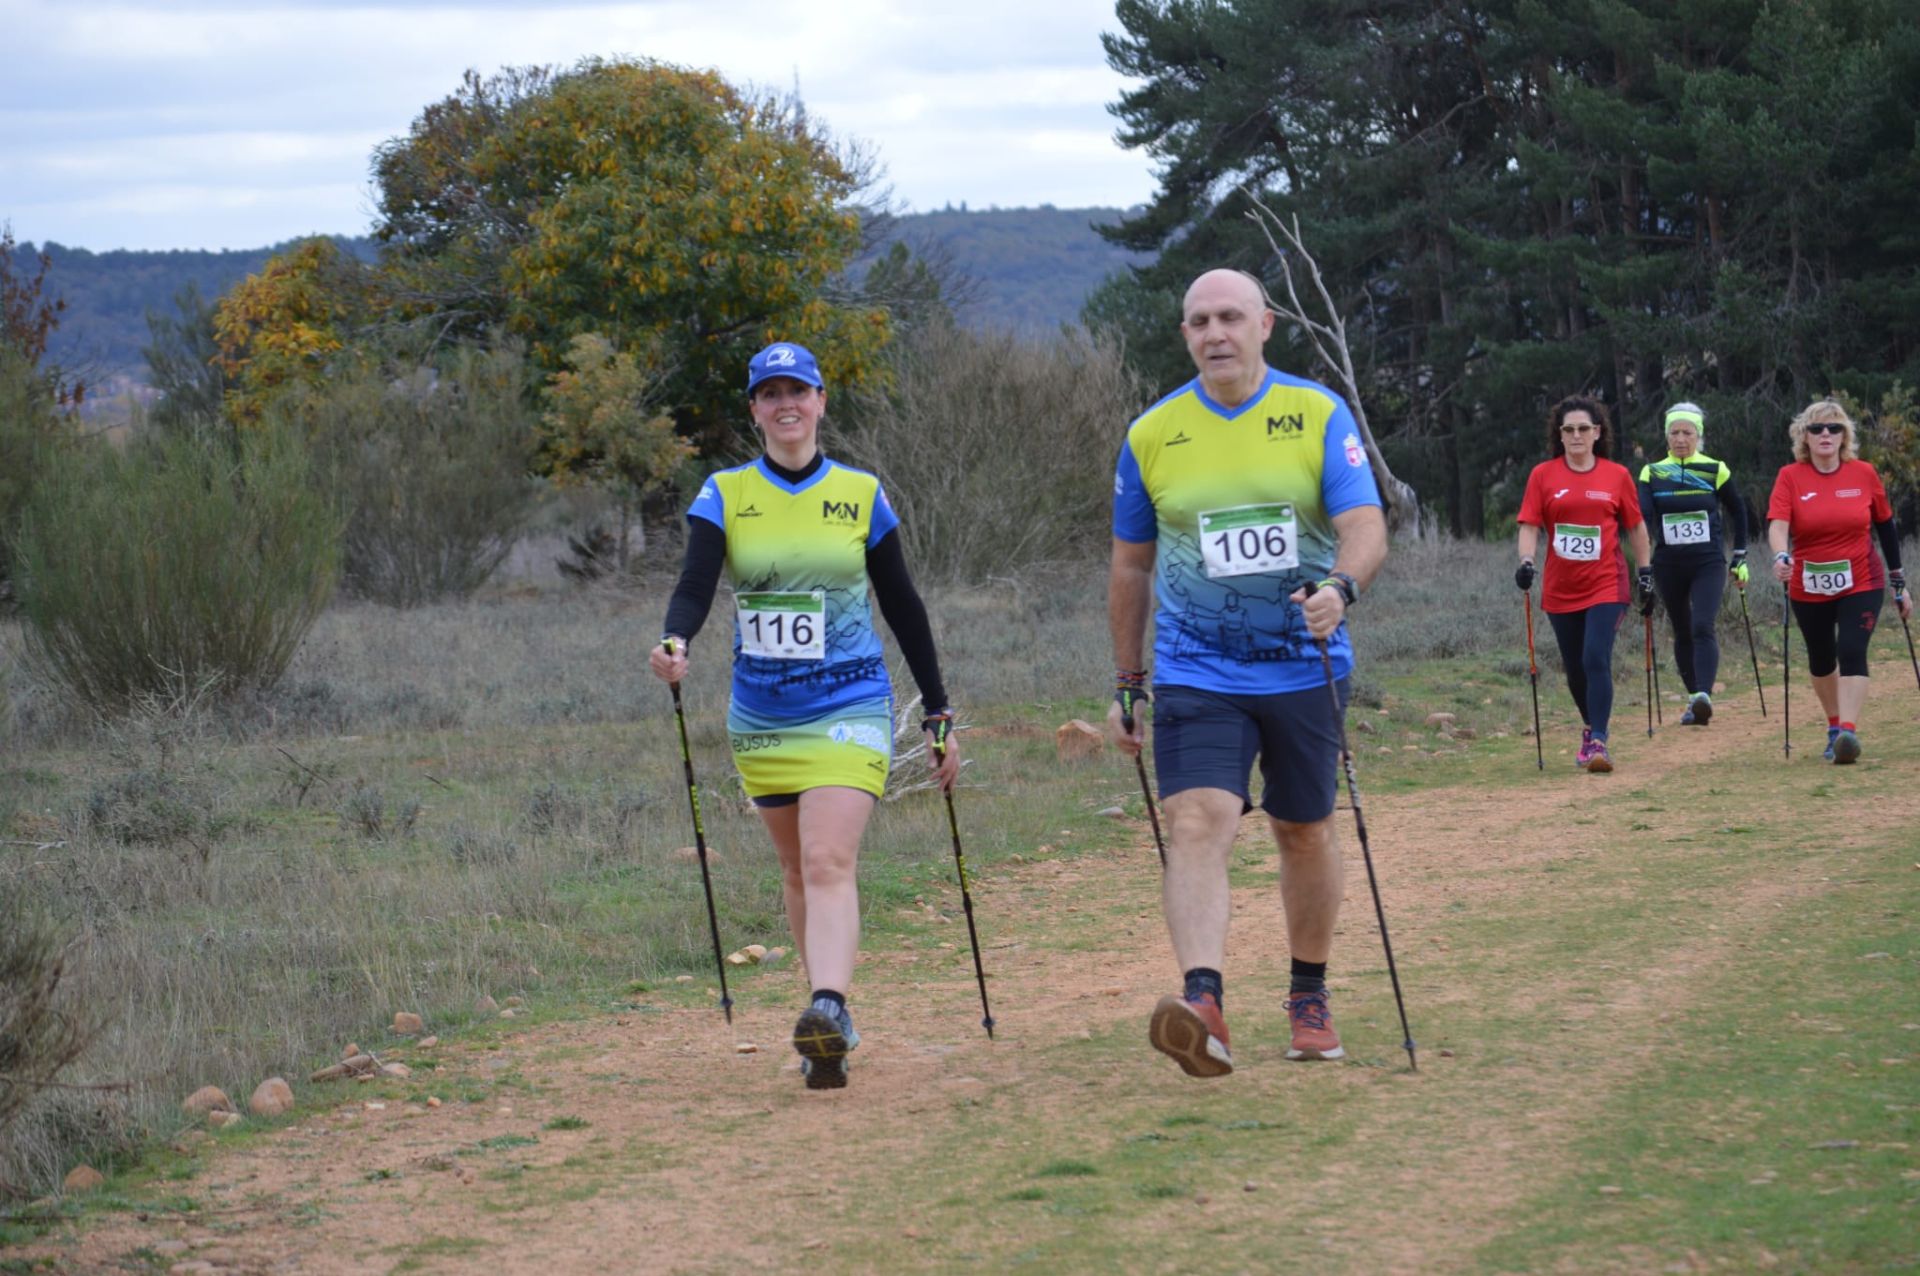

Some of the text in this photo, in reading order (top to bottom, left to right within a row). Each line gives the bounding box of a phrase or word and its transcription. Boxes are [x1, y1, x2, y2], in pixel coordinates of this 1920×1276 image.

[1669, 521, 1704, 538] 133
[1214, 525, 1286, 562] 106
[1559, 536, 1595, 554] 129
[1808, 572, 1846, 590] 130
[748, 612, 814, 646] 116
